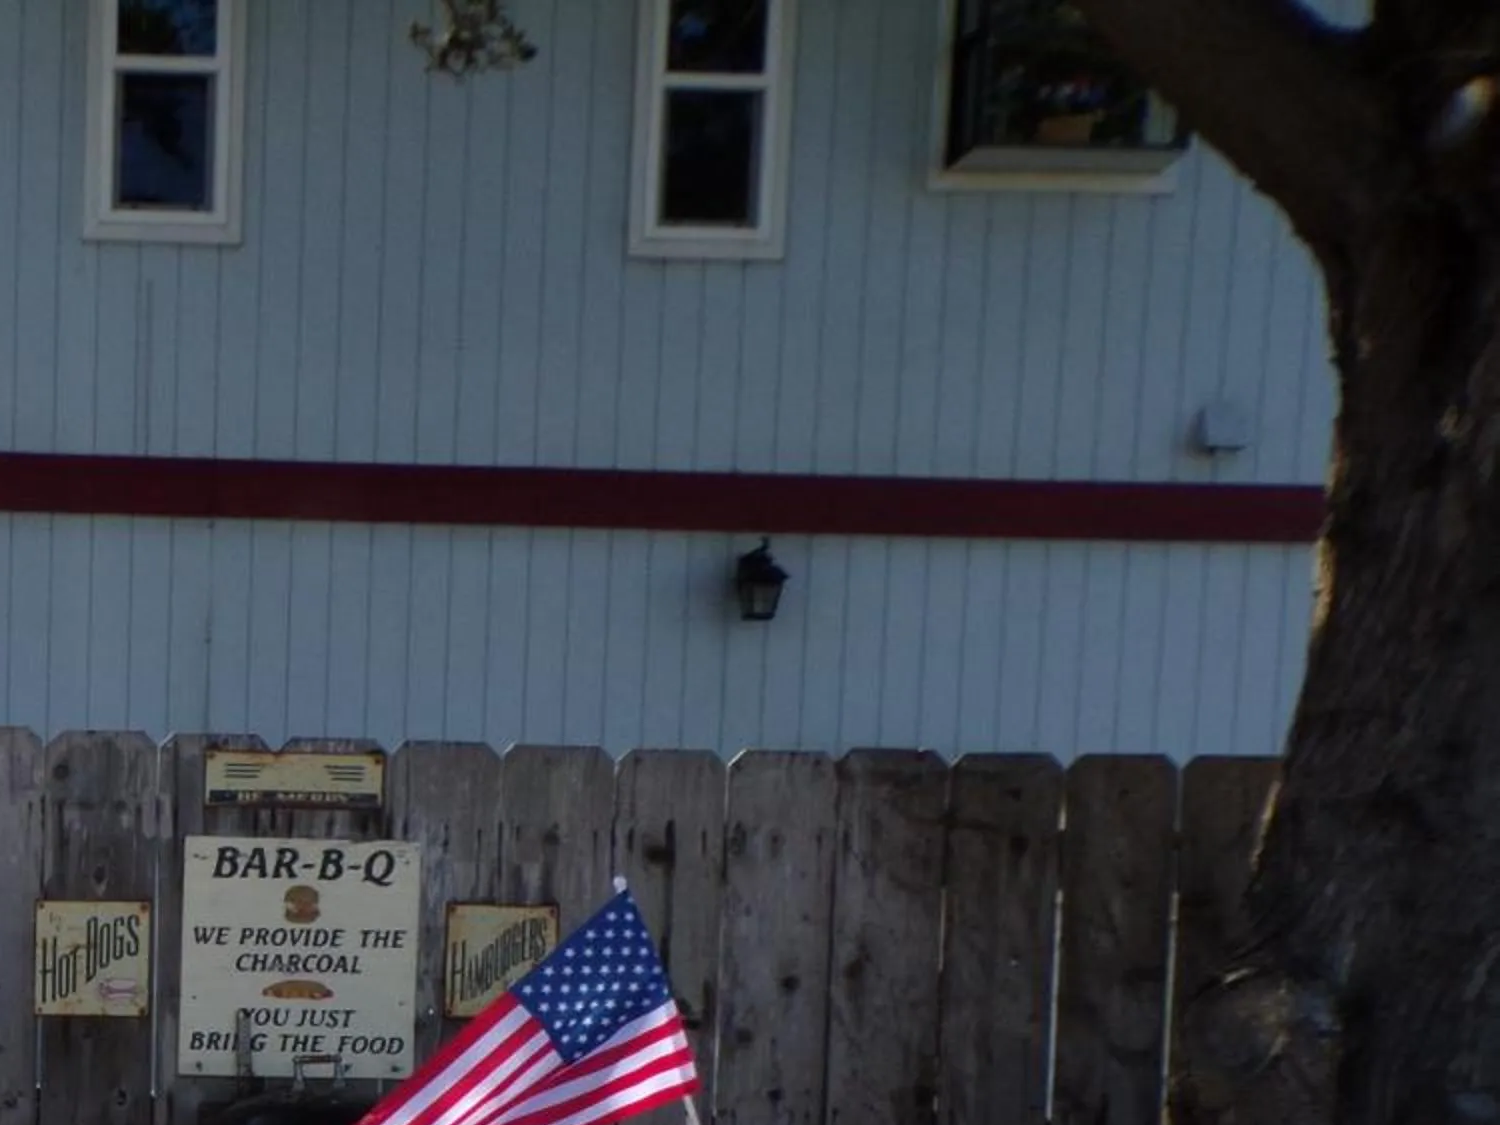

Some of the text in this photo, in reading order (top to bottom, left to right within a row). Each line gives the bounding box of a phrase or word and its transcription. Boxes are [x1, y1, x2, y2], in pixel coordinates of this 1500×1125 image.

[213, 846, 396, 887] BAR-B-Q
[85, 914, 140, 983] DOGS
[193, 926, 407, 949] WE PROVIDE THE
[235, 953, 362, 974] CHARCOAL
[239, 1007, 355, 1028] YOU JUST
[190, 1031, 405, 1055] BRIG THE FOOD
